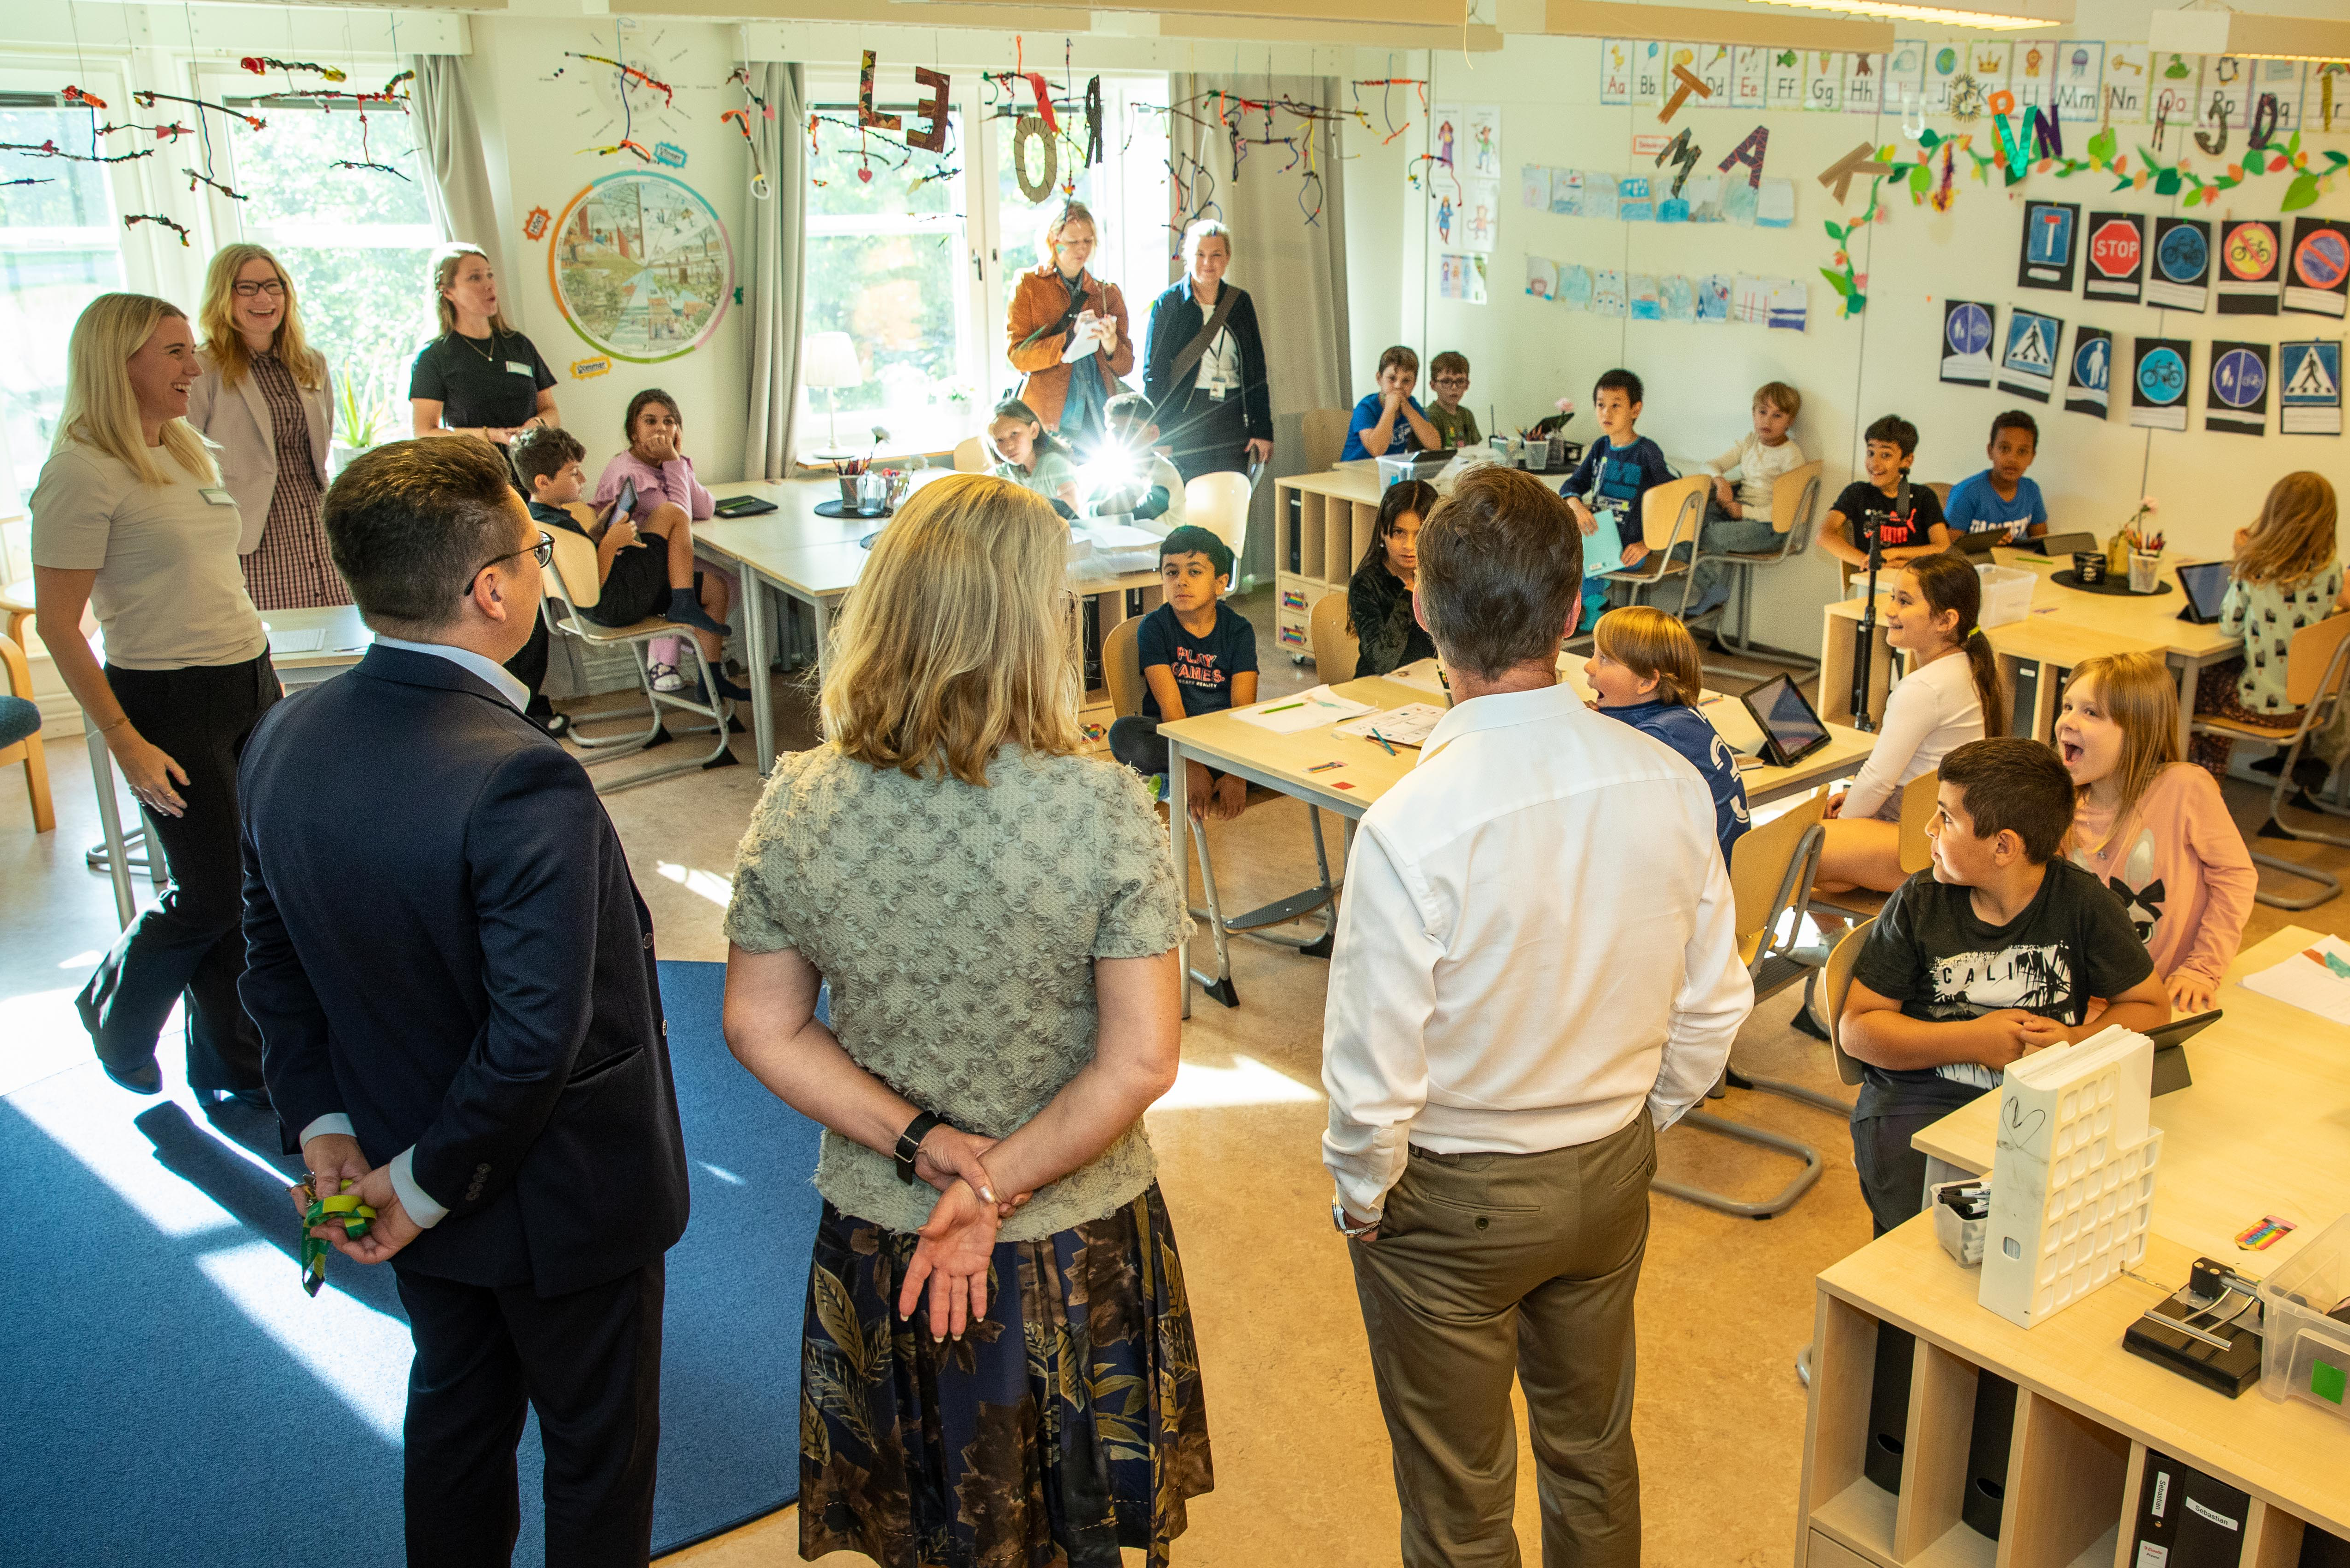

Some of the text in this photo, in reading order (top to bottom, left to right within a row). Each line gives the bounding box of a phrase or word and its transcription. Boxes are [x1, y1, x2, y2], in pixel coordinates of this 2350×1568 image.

[1608, 75, 1626, 94] Aa
[1640, 75, 1656, 95] Bb
[1740, 76, 1758, 97] Ee
[1778, 77, 1796, 99] Ff
[1812, 78, 1834, 107] Gg
[1850, 80, 1873, 102] Hh
[2057, 86, 2095, 109] Mm
[2110, 86, 2136, 110] Nn
[2096, 239, 2138, 258] STOP
[1177, 646, 1218, 668] PLAY
[1942, 962, 2013, 985] CALI
[2155, 1479, 2166, 1511] Sebastian
[2195, 1505, 2229, 1526] Sebastian
